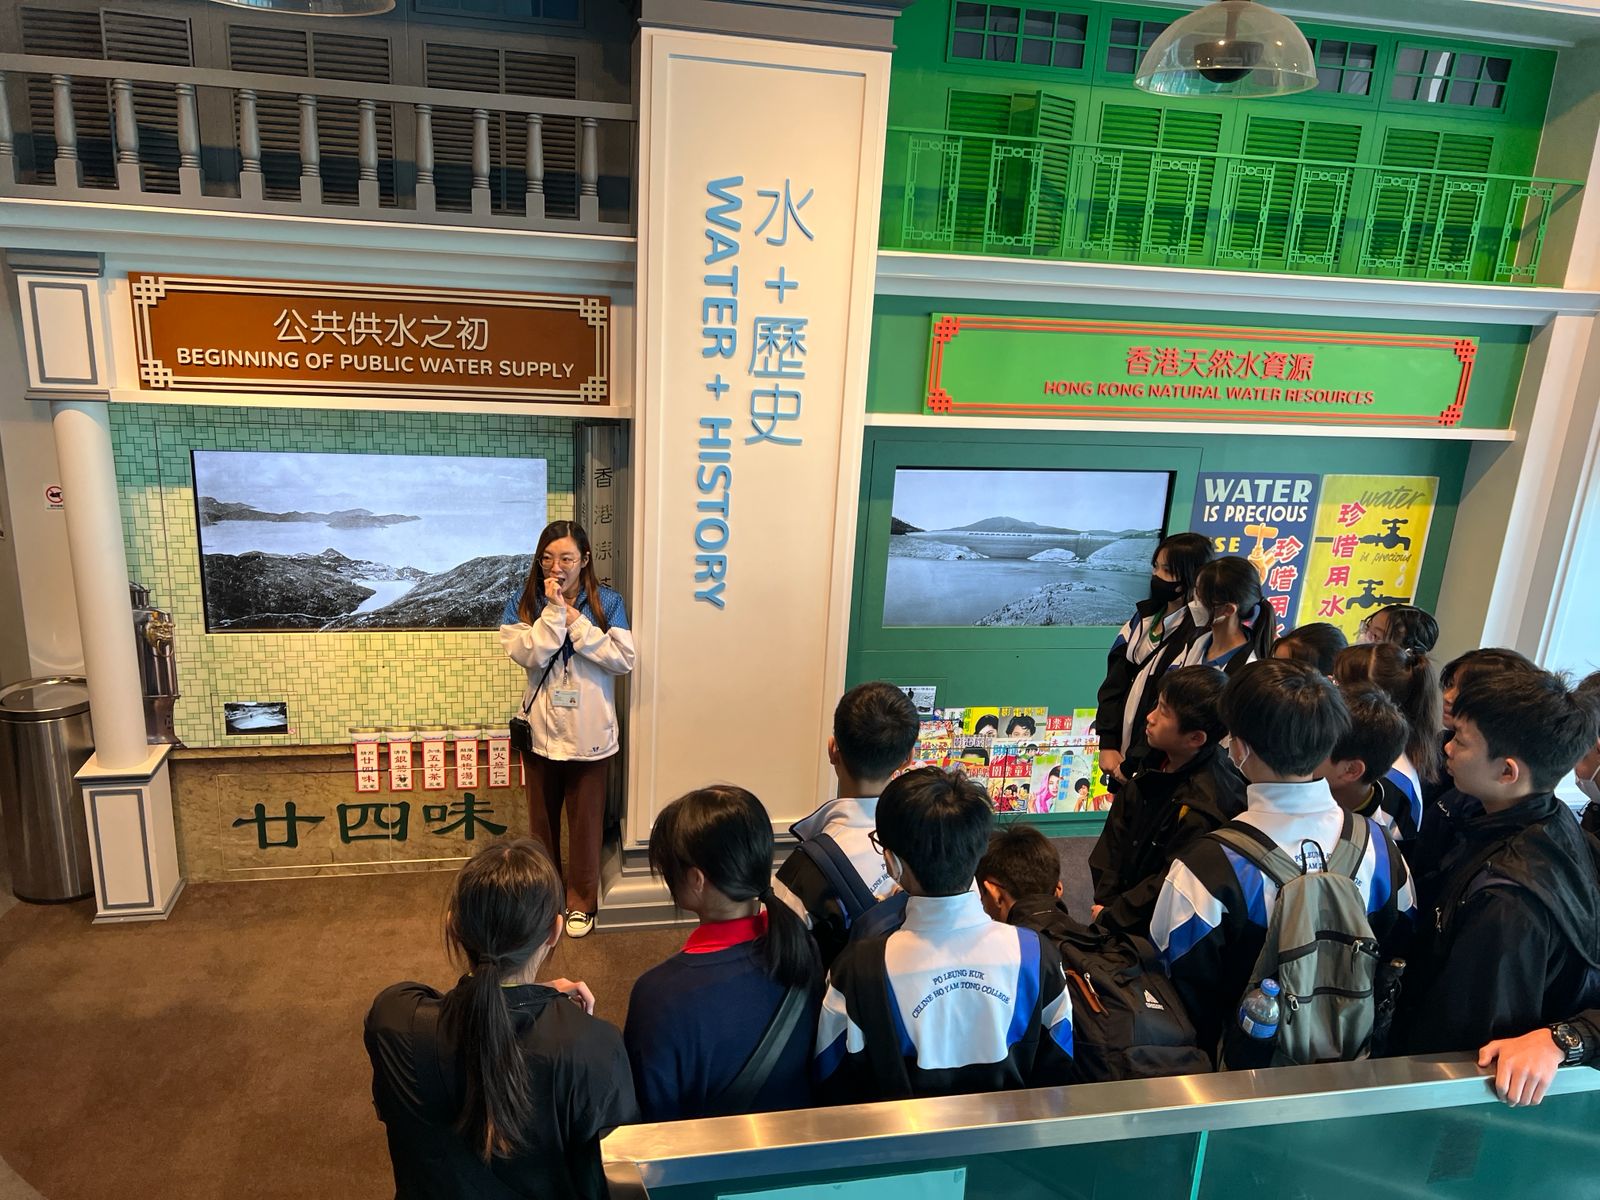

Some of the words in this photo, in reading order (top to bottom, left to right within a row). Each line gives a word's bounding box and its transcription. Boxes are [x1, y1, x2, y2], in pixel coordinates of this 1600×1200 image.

[702, 176, 744, 358] WATER
[274, 308, 490, 351] 公共供水之初
[176, 347, 299, 370] BEGINNING
[305, 353, 334, 369] OF
[340, 353, 414, 373] PUBLIC
[420, 356, 493, 376] WATER
[499, 359, 575, 378] SUPPLY
[1126, 345, 1315, 381] 香港天然水資源
[706, 374, 730, 400] +
[1044, 380, 1093, 397] HONG
[1097, 382, 1145, 398] KONG
[1148, 384, 1222, 400] NATURAL
[1226, 386, 1282, 401] WATER
[1285, 388, 1375, 405] RESOURCES
[1204, 479, 1313, 503] WATER
[1359, 486, 1426, 510] water
[694, 417, 732, 610] HISTORY
[1203, 505, 1220, 522] IS
[1224, 505, 1308, 522] PRECIOUS
[1210, 537, 1241, 553] SE
[1360, 551, 1370, 562] is
[1371, 551, 1412, 565] precious
[1318, 502, 1367, 617] 珍惜用水
[232, 792, 508, 849] 廿四味
[933, 976, 943, 985] PO
[944, 969, 967, 980] LEUNG
[969, 970, 985, 980] KUK
[912, 994, 934, 1018] CELINE
[933, 988, 945, 998] HO
[944, 982, 960, 993] YAM
[960, 981, 980, 990] TONG
[981, 985, 1010, 1004] COLLEGE
